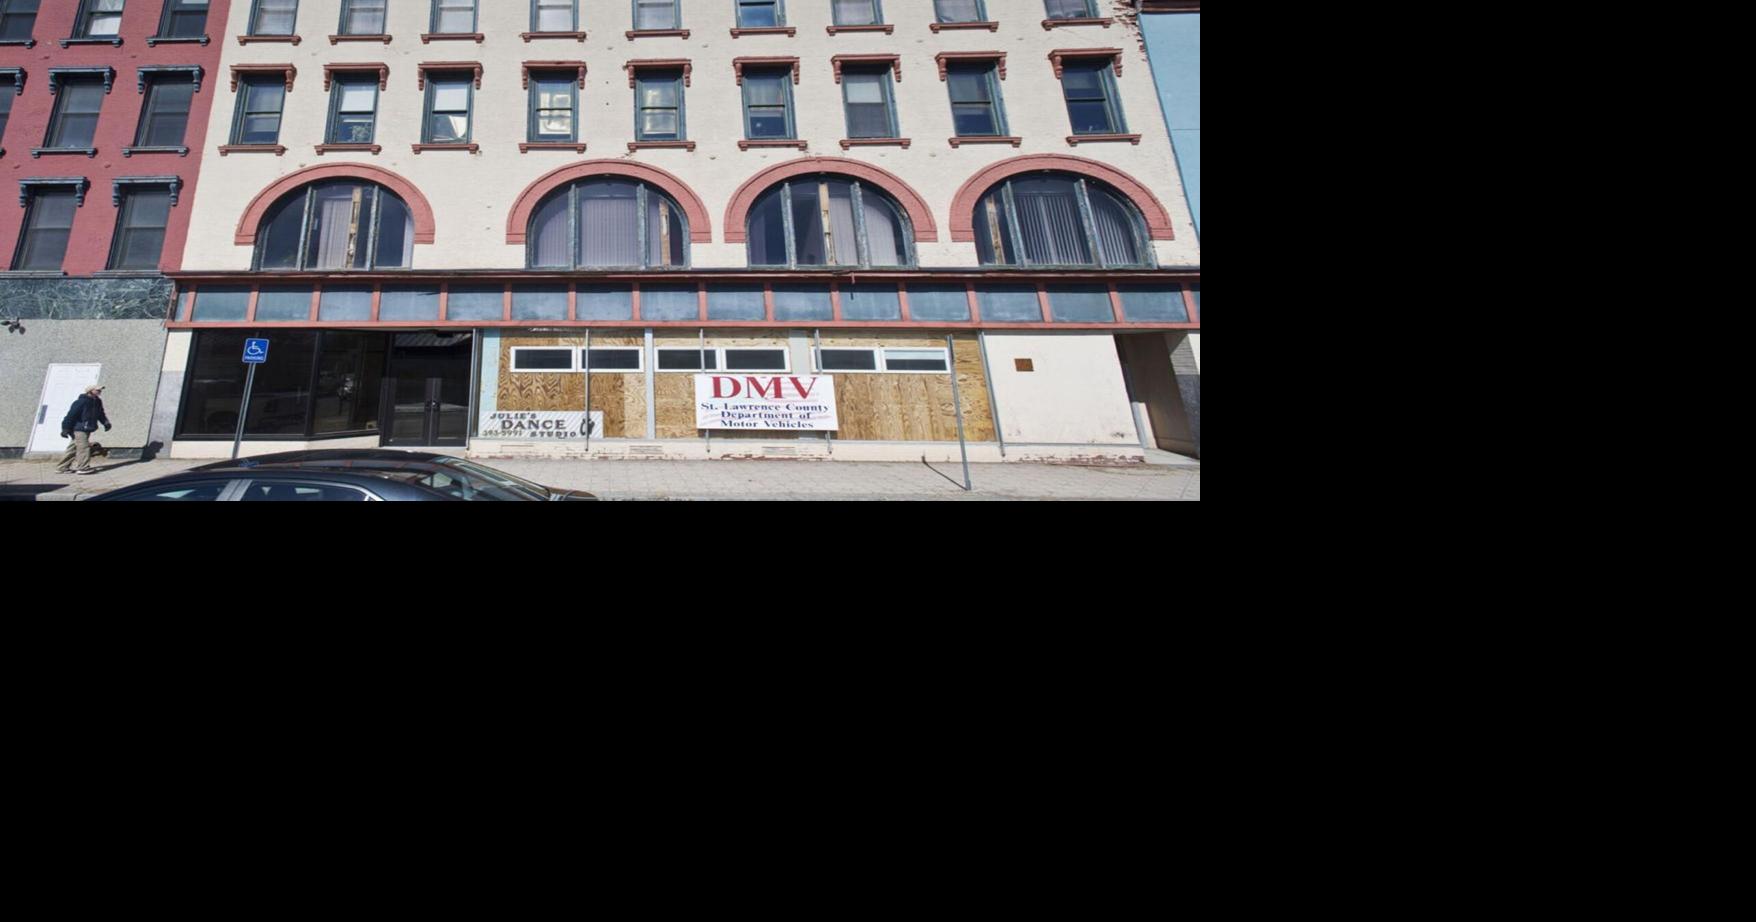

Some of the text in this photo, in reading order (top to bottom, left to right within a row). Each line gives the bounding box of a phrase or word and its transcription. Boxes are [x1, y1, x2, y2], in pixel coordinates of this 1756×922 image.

[711, 376, 817, 399] DMV
[724, 403, 781, 411] Lawrence
[786, 404, 828, 412] County
[490, 412, 537, 420] JULIE'S
[721, 411, 811, 420] Department of
[501, 420, 567, 430] DANCE
[765, 420, 814, 428] Vehicles
